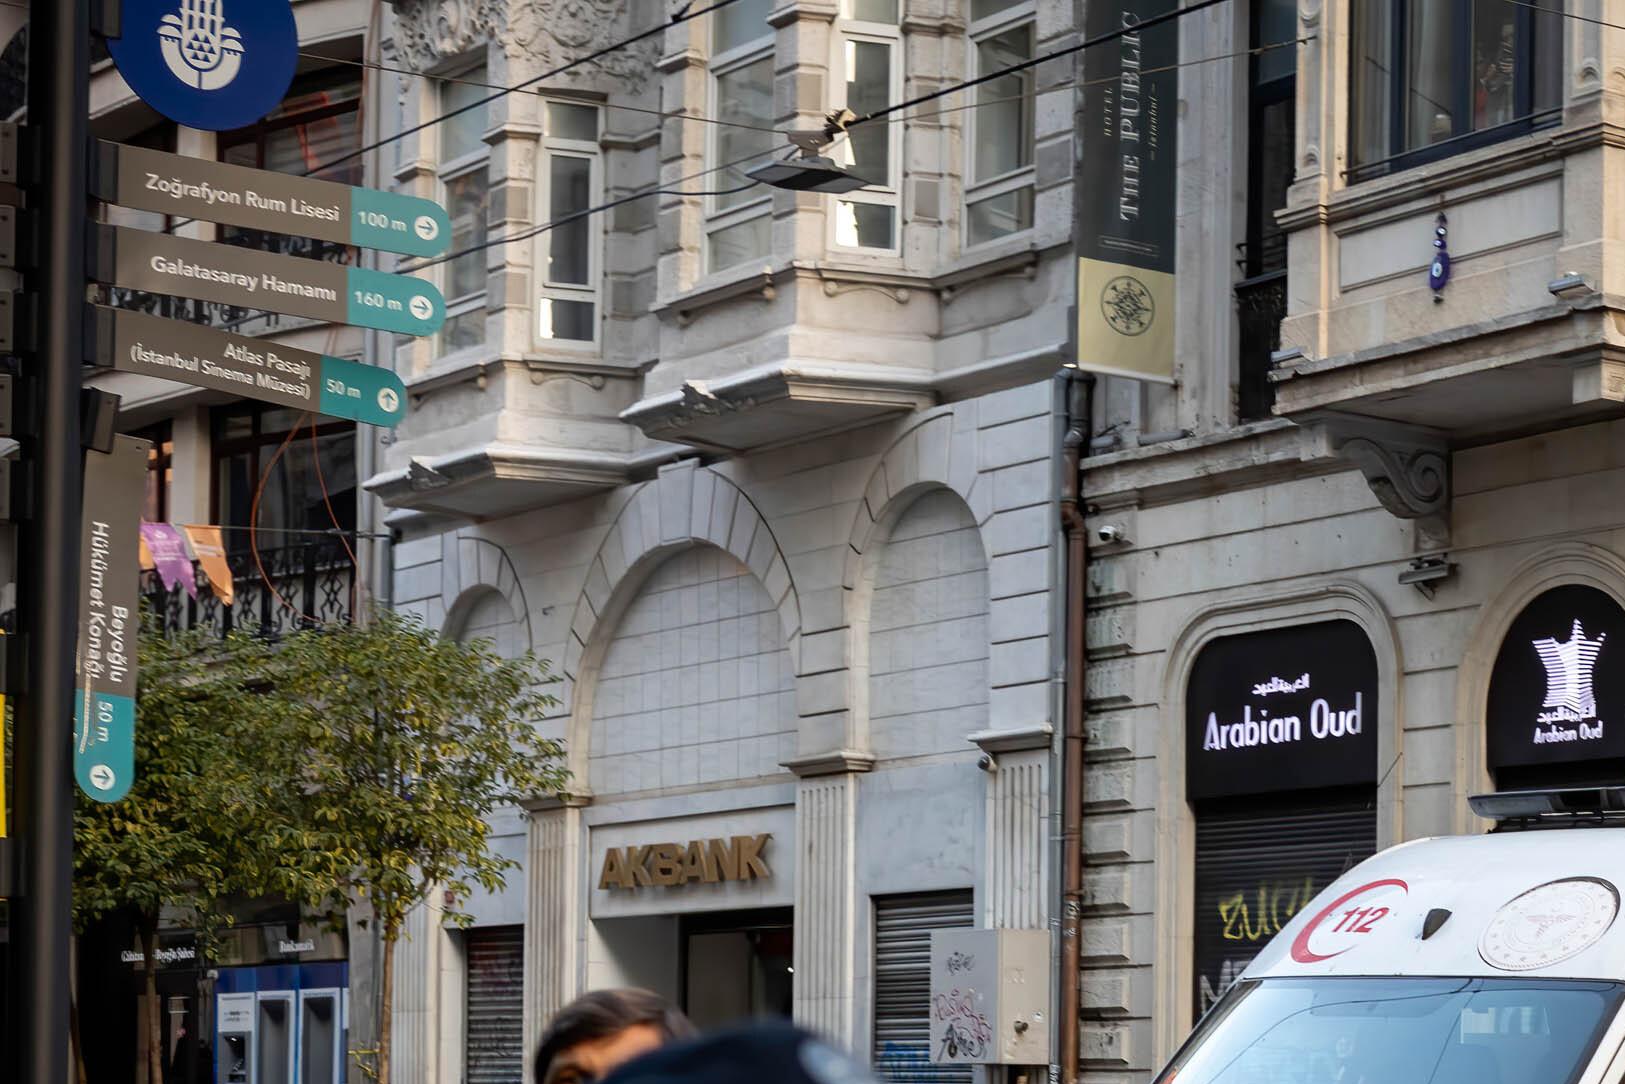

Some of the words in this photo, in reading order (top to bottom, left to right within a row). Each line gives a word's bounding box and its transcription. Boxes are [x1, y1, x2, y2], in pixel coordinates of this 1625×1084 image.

[1119, 11, 1142, 144] PUBLIC
[1104, 87, 1113, 137] HOTEL
[146, 173, 241, 205] Zoğrafyon
[245, 190, 287, 213] Rum
[291, 198, 340, 222] Lisesi
[1119, 155, 1140, 221] THE
[358, 210, 389, 229] 100
[392, 220, 408, 232] m
[150, 255, 258, 292] Galatasaray
[262, 274, 337, 302] Hamamı
[354, 291, 385, 308] 160
[388, 299, 403, 312] m
[130, 342, 199, 373] (İstanbul
[201, 359, 254, 386] Sinema
[256, 372, 311, 400] Müzesi)
[224, 342, 264, 367] Atlas
[267, 352, 311, 380] Pasajı
[325, 378, 345, 395] 50
[347, 386, 361, 400] m
[89, 521, 110, 607] Hükümet
[109, 605, 130, 684] Beyoğlu
[97, 701, 114, 723] 50
[97, 727, 109, 743] m
[1203, 705, 1301, 751] Arabian
[1310, 691, 1362, 739] Oud
[1533, 724, 1578, 744] Arabian
[1579, 720, 1603, 740] Oud
[599, 833, 774, 890] AKBANK
[1332, 906, 1390, 934] 112
